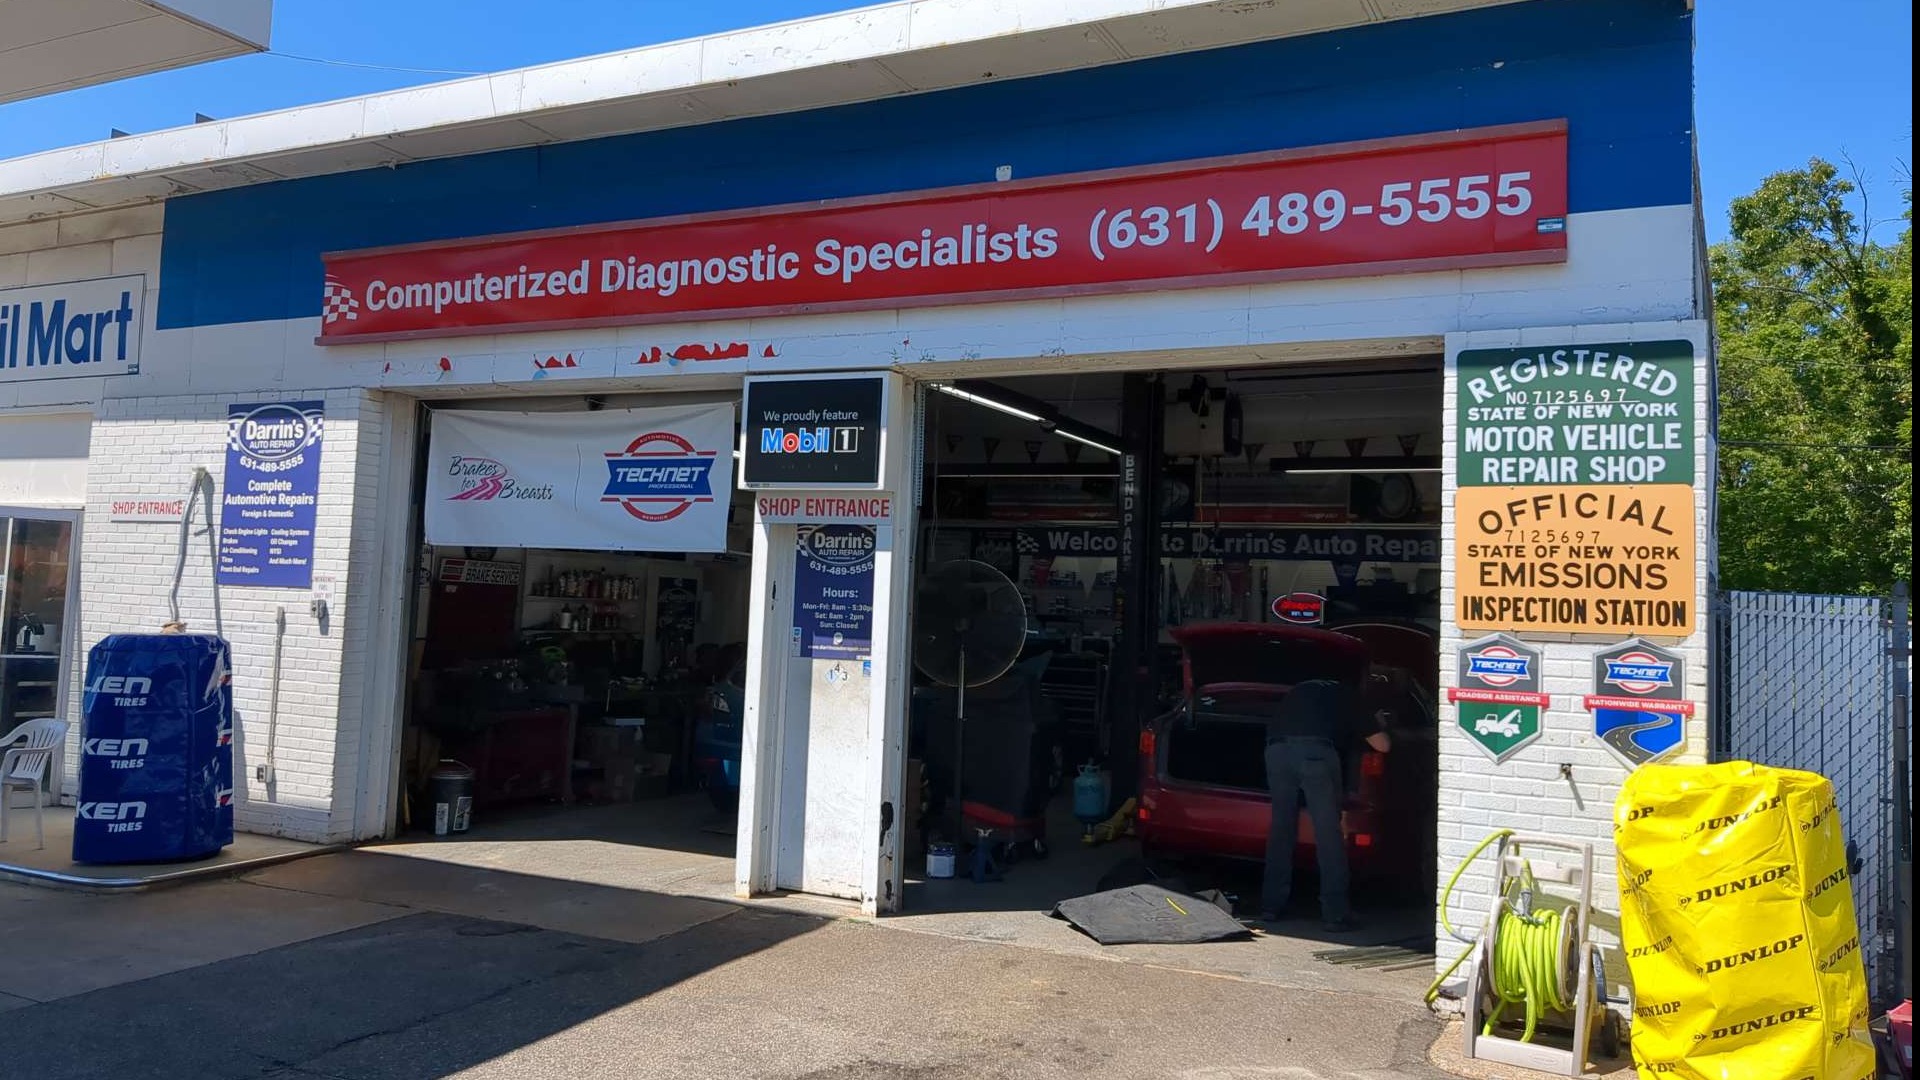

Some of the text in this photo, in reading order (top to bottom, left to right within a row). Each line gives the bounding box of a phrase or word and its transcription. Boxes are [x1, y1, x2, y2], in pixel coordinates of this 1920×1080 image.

[366, 171, 1533, 314] Computerized Diagnostic Specialists (631) 489-5555
[26, 291, 132, 367] Mart
[1466, 349, 1678, 404] REGISTERED
[1533, 388, 1627, 405] 7125697
[763, 409, 859, 424] We proudly feature
[1467, 402, 1679, 421] STATE OF NEW YORK
[245, 418, 305, 440] Darrin's
[1465, 423, 1682, 452] MOTOR VEHICLE
[250, 440, 295, 449] AUTO REPAIR
[761, 427, 830, 453] Mobil
[240, 454, 305, 473] 631-489-5555
[449, 456, 498, 476] Brakes
[1482, 456, 1666, 483] REPAIR SHOP
[248, 479, 292, 493] Complete
[461, 477, 476, 491] for
[498, 479, 554, 500] Breasts
[112, 500, 184, 515] SHOP ENTRANCE
[225, 493, 314, 507] Automotive Repairs
[759, 497, 890, 517] SHOP ENTRANCE
[1478, 492, 1674, 536] OFFICIAL
[814, 532, 873, 549] Darrin's
[1292, 533, 1358, 554] Auto
[1505, 530, 1601, 544] 7125697
[1467, 544, 1680, 560] STATE OF NEW YORK
[809, 560, 874, 575] 631-489-5555
[1479, 562, 1668, 591] EMISSIONS
[823, 587, 859, 598] Hours:
[852, 604, 873, 613] 5:30p
[1462, 596, 1687, 627] INSPECTION STATION
[114, 697, 147, 707] TIRES
[1456, 691, 1541, 703] ROADSIDE ASSISTANCE
[1588, 699, 1689, 711] NATIONWIDE WARRANTY
[110, 758, 144, 769] TIRES
[1694, 795, 1781, 833] DUNOP
[108, 822, 143, 833] TIRES
[1696, 864, 1791, 902] DUNLOP
[1631, 935, 1673, 958] DUNLOP
[1705, 934, 1804, 974] DUNLOP
[1636, 1001, 1681, 1018] DUNLOP
[1710, 1006, 1813, 1040] DUNLOP
